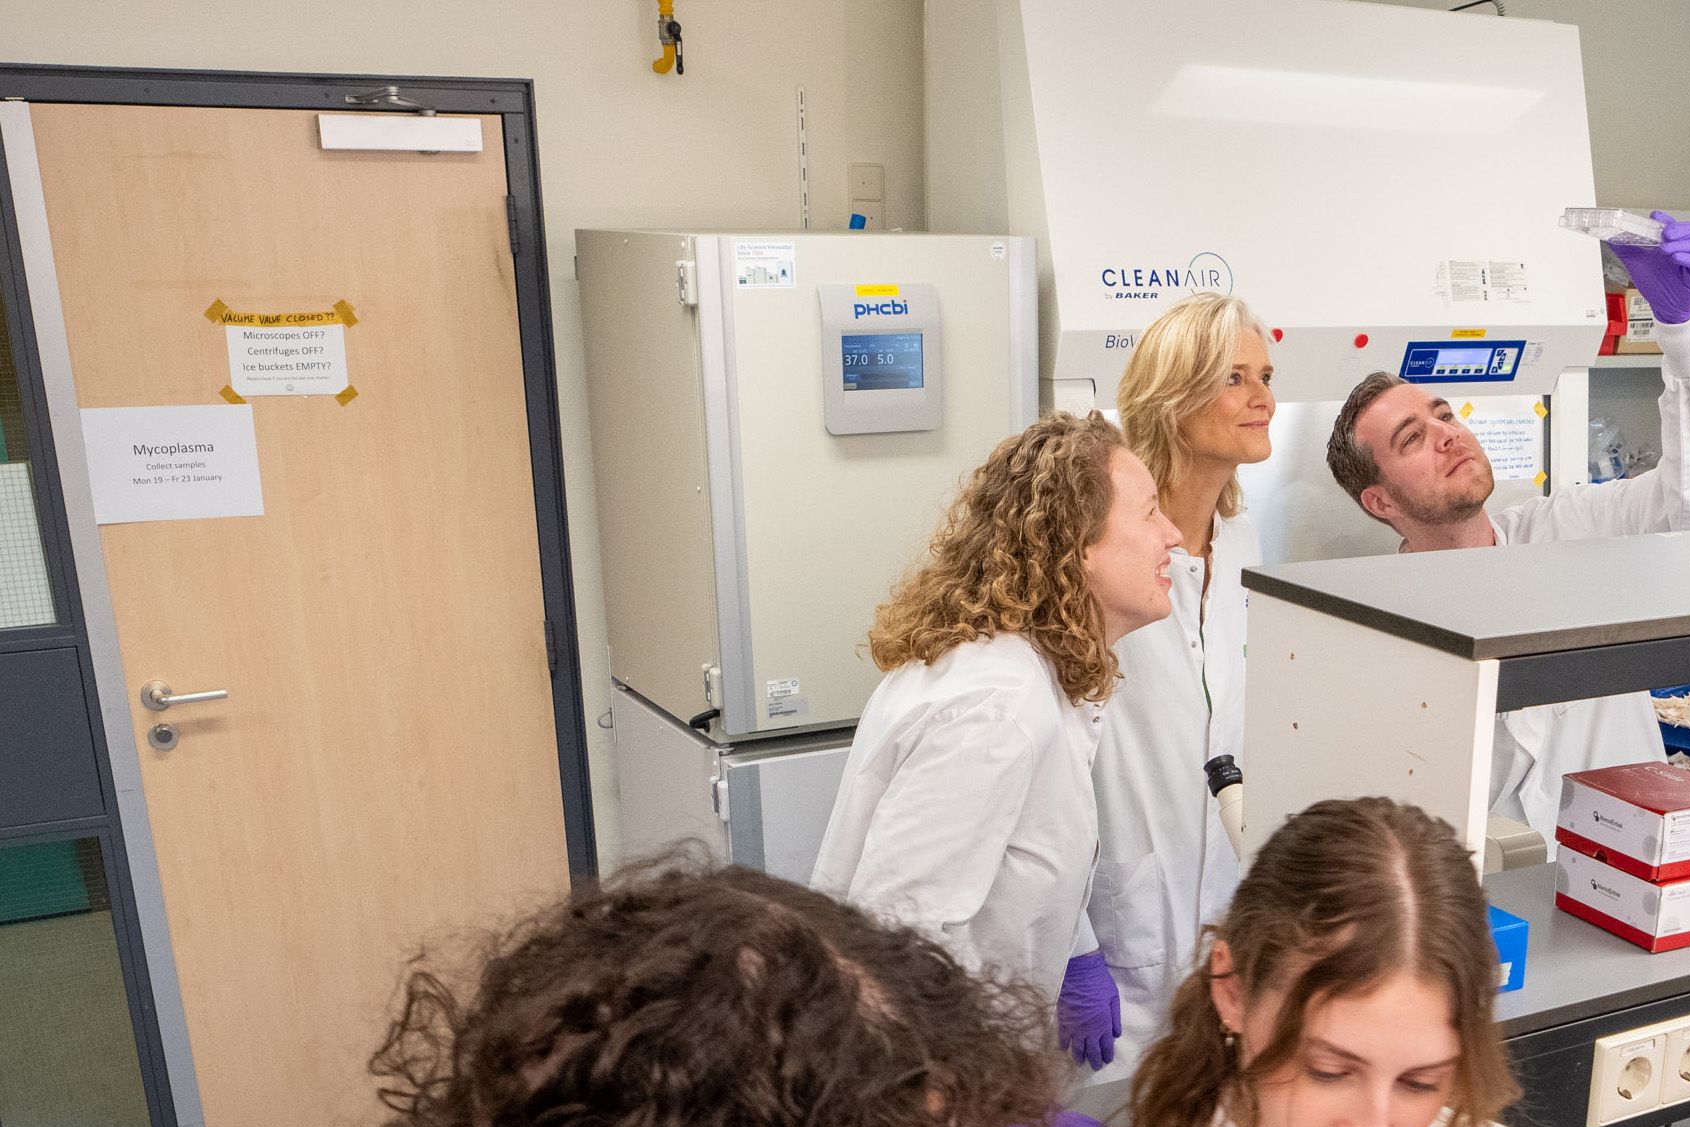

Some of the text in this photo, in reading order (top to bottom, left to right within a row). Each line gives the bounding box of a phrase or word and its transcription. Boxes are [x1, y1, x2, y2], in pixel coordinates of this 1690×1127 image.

[243, 331, 325, 341] Microscopes OFF?
[247, 346, 323, 357] Centrifuges OFF?
[844, 353, 894, 366] 37.0 5.0
[258, 363, 294, 371] buckets
[296, 362, 331, 371] EMPTY?
[133, 443, 214, 457] Mycoplasma
[146, 461, 206, 471] Collect samples
[132, 477, 151, 485] Mon
[193, 474, 222, 483] January
